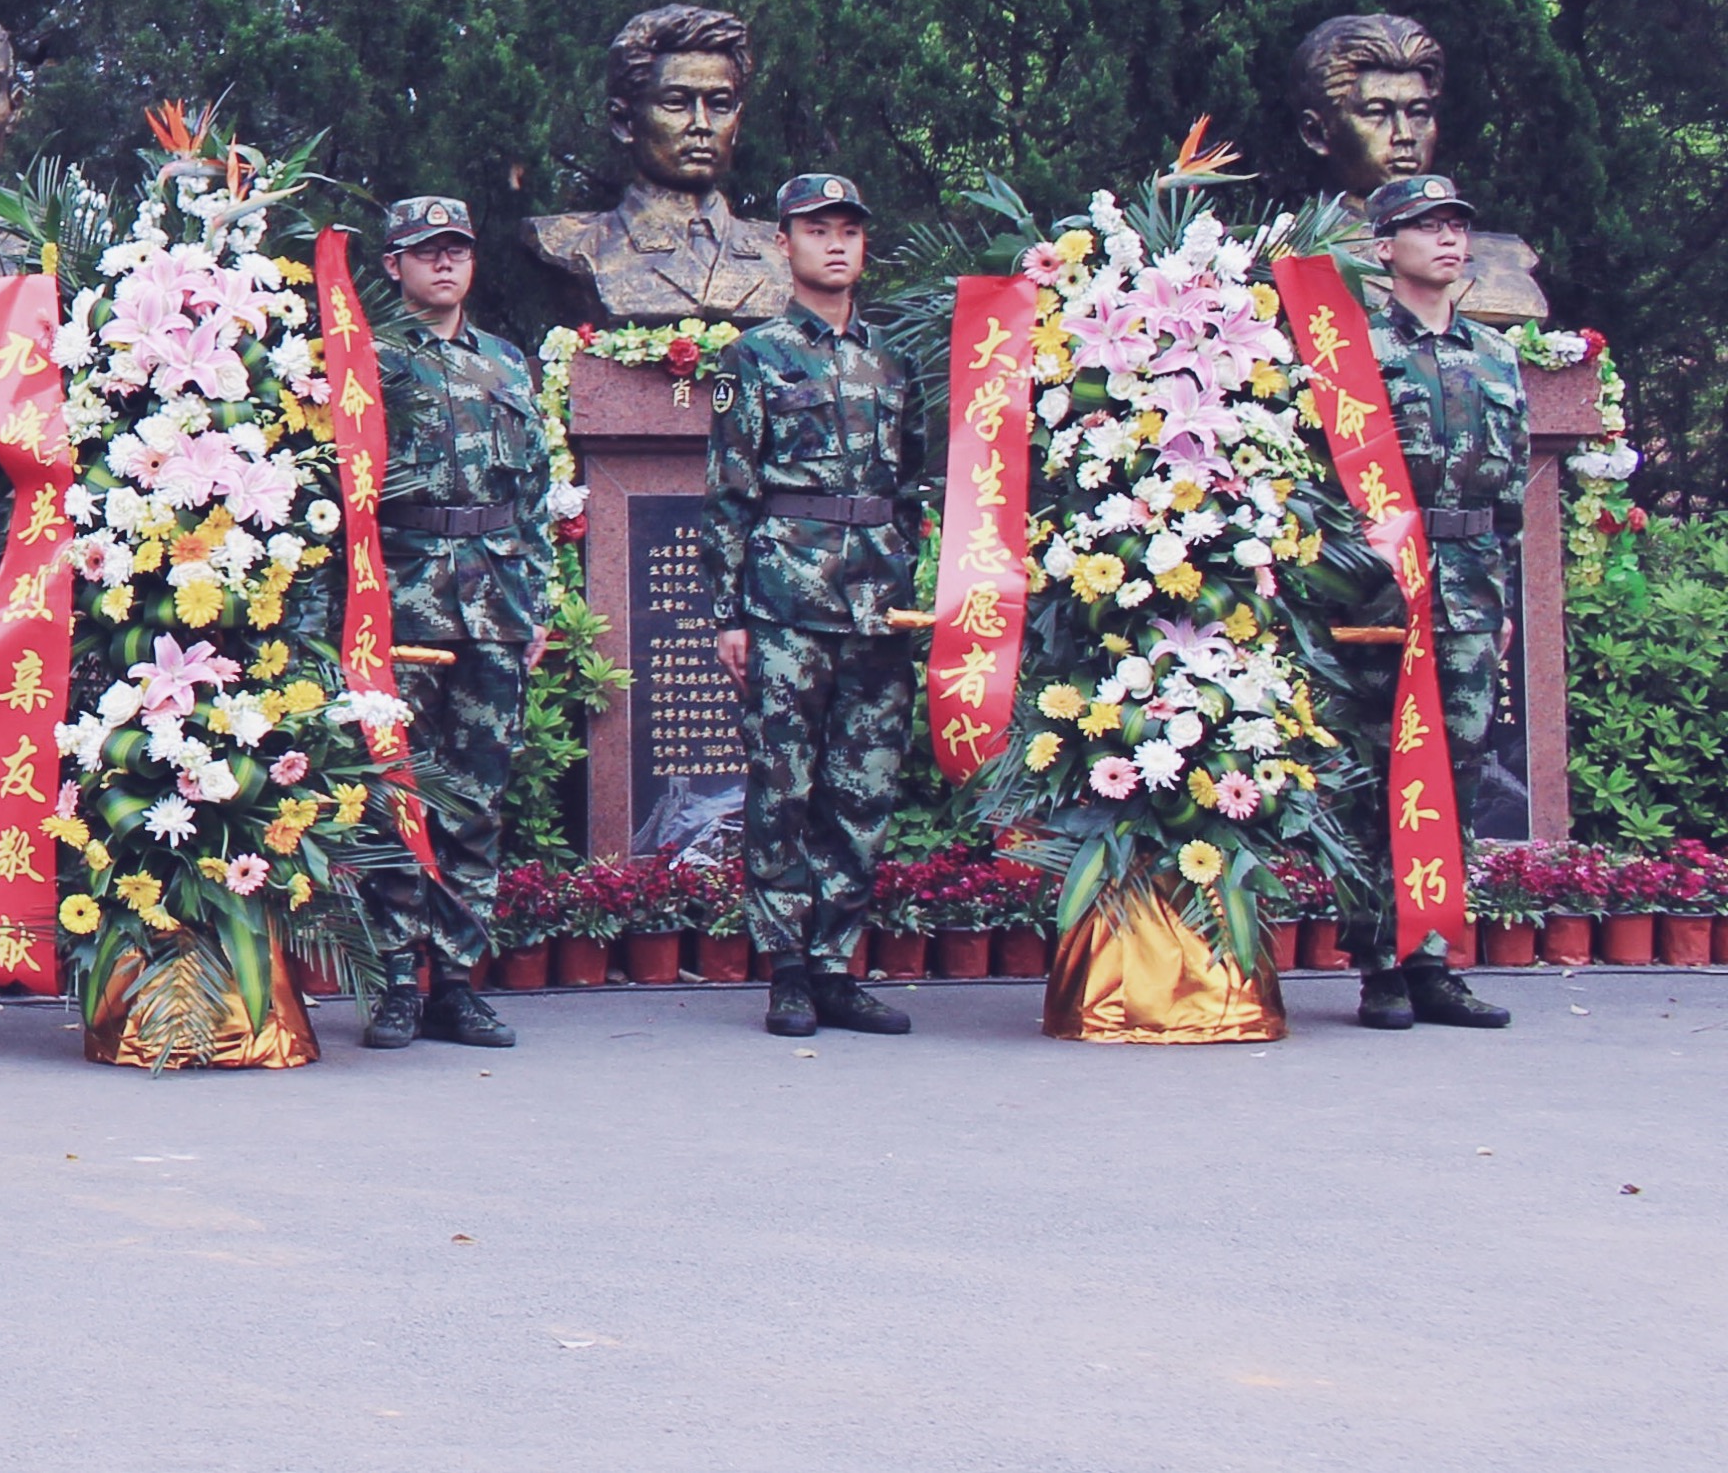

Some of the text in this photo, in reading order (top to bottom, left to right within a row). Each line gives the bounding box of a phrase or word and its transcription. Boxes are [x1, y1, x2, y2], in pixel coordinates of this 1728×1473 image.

[1307, 303, 1447, 910] 革命英烈永垂不朽
